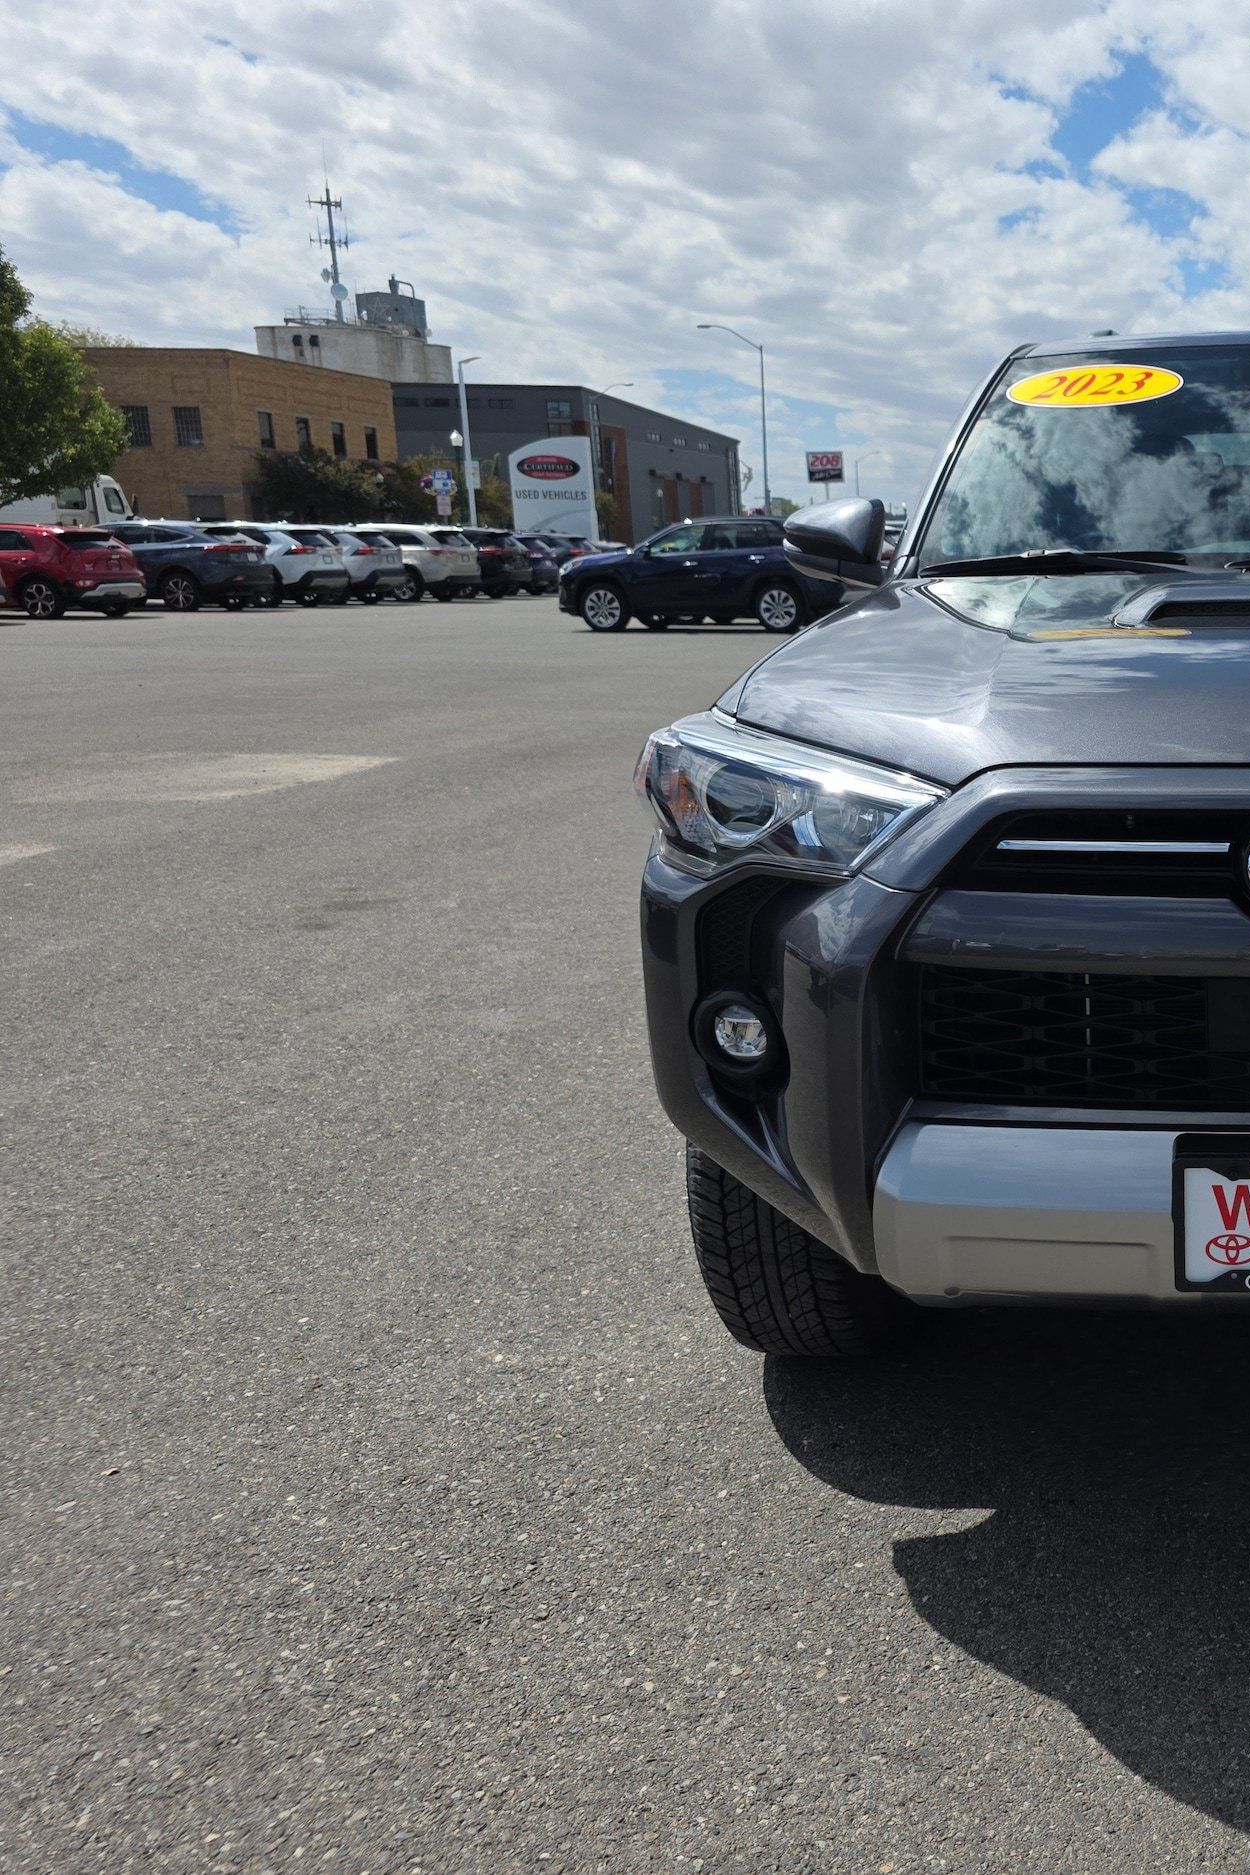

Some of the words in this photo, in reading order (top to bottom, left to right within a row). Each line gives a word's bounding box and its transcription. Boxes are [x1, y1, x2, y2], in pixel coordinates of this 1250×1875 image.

[1031, 371, 1153, 400] 2023
[811, 454, 840, 467] 208
[515, 489, 539, 499] USED
[541, 489, 587, 501] VEHICLES
